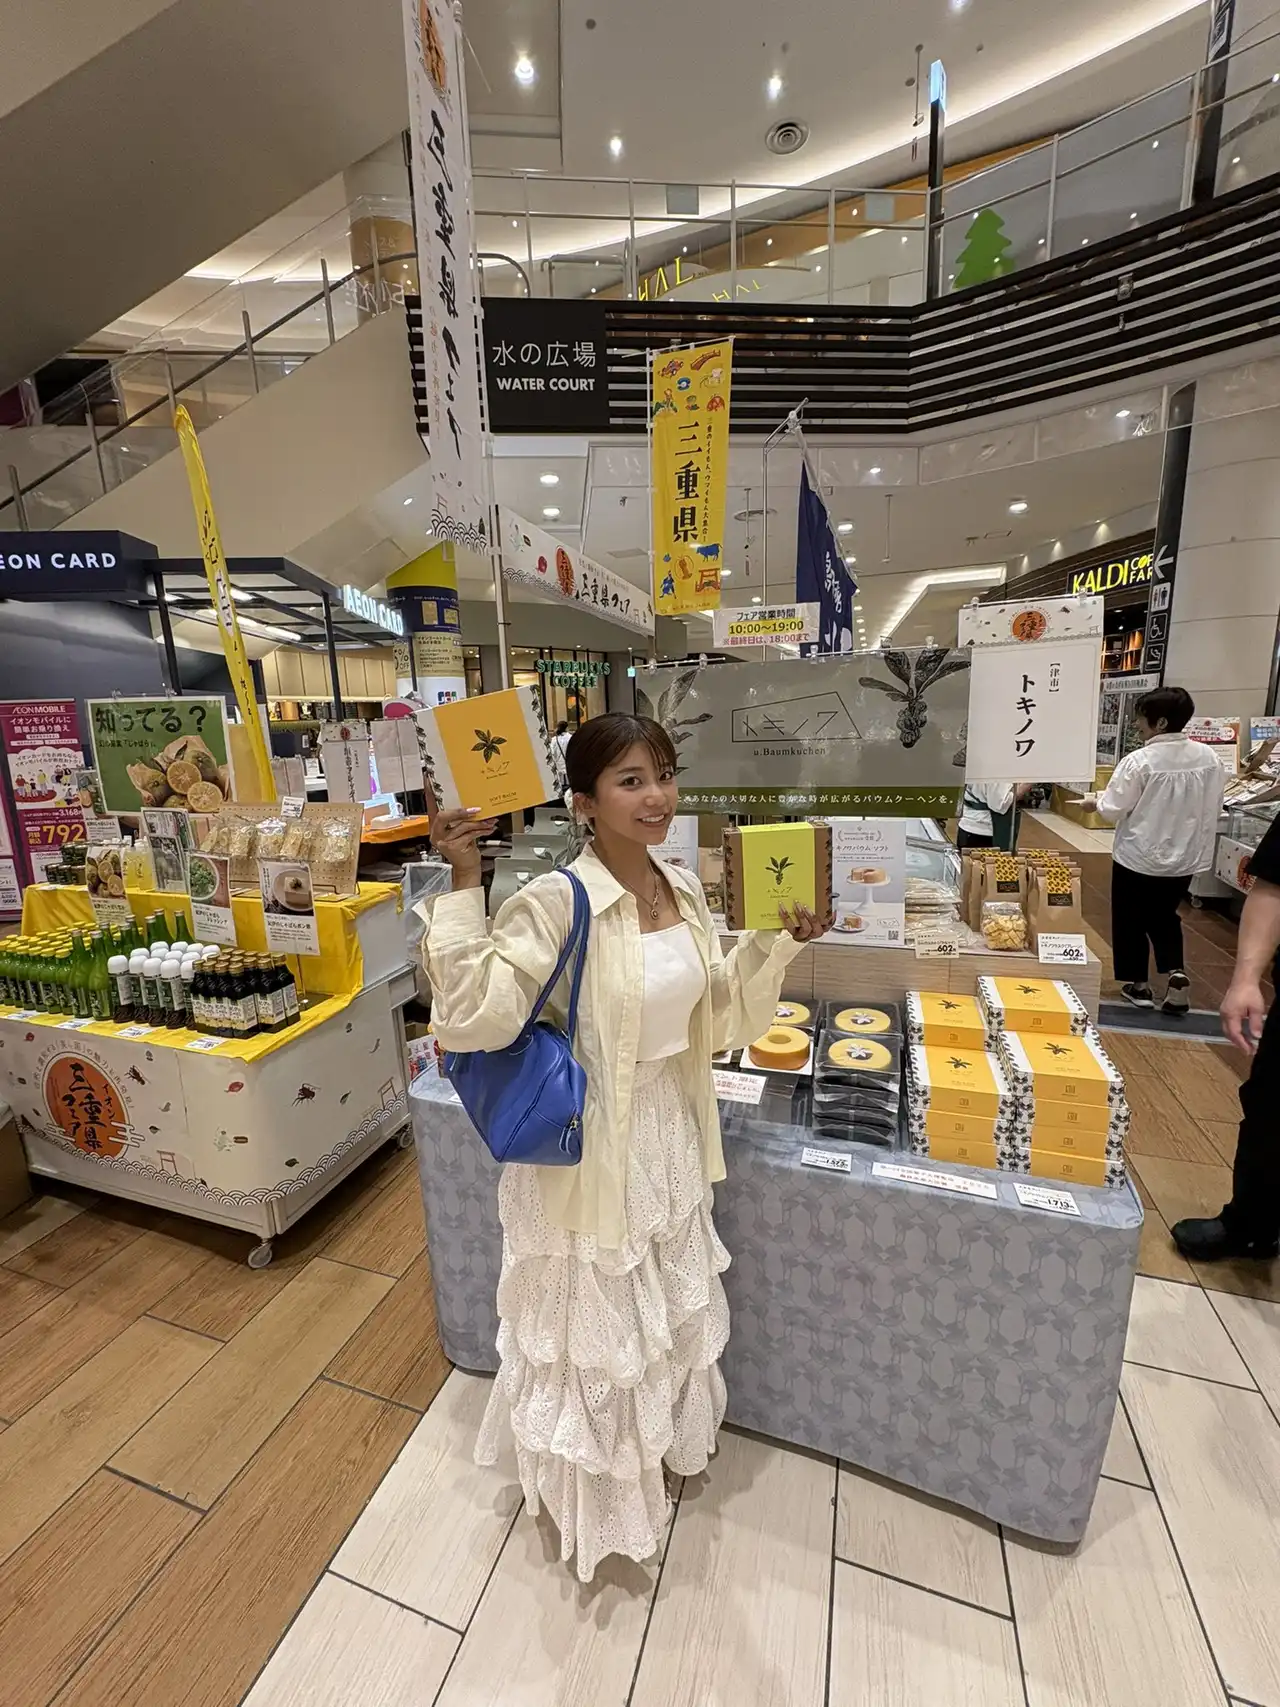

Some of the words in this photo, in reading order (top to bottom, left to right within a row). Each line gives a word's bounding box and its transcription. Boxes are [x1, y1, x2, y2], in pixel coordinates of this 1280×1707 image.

[492, 340, 596, 367] 水の広場
[497, 377, 545, 390] WATER
[549, 377, 595, 390] COURT
[673, 420, 703, 543] 三重県
[51, 552, 117, 569] CARD
[1131, 553, 1154, 571] COF
[1072, 559, 1130, 595] KALDI
[1129, 566, 1153, 584] FAR
[344, 583, 379, 624] AEON
[379, 603, 404, 637] CARD
[736, 608, 797, 621] フェア営業時間
[537, 658, 611, 676] STARBUCKS
[553, 675, 598, 688] COFFEE
[11, 717, 72, 725] イオンモバイルに
[95, 705, 207, 733] 知ってる？
[1015, 674, 1037, 757] トキノワ
[14, 725, 71, 734] 簡単お乗り換え
[753, 746, 827, 756] u.Baumkuchen
[42, 823, 85, 844] 792
[69, 1062, 107, 1149] 三重県
[102, 1083, 116, 1119] イオン
[62, 1094, 82, 1136] フェア
